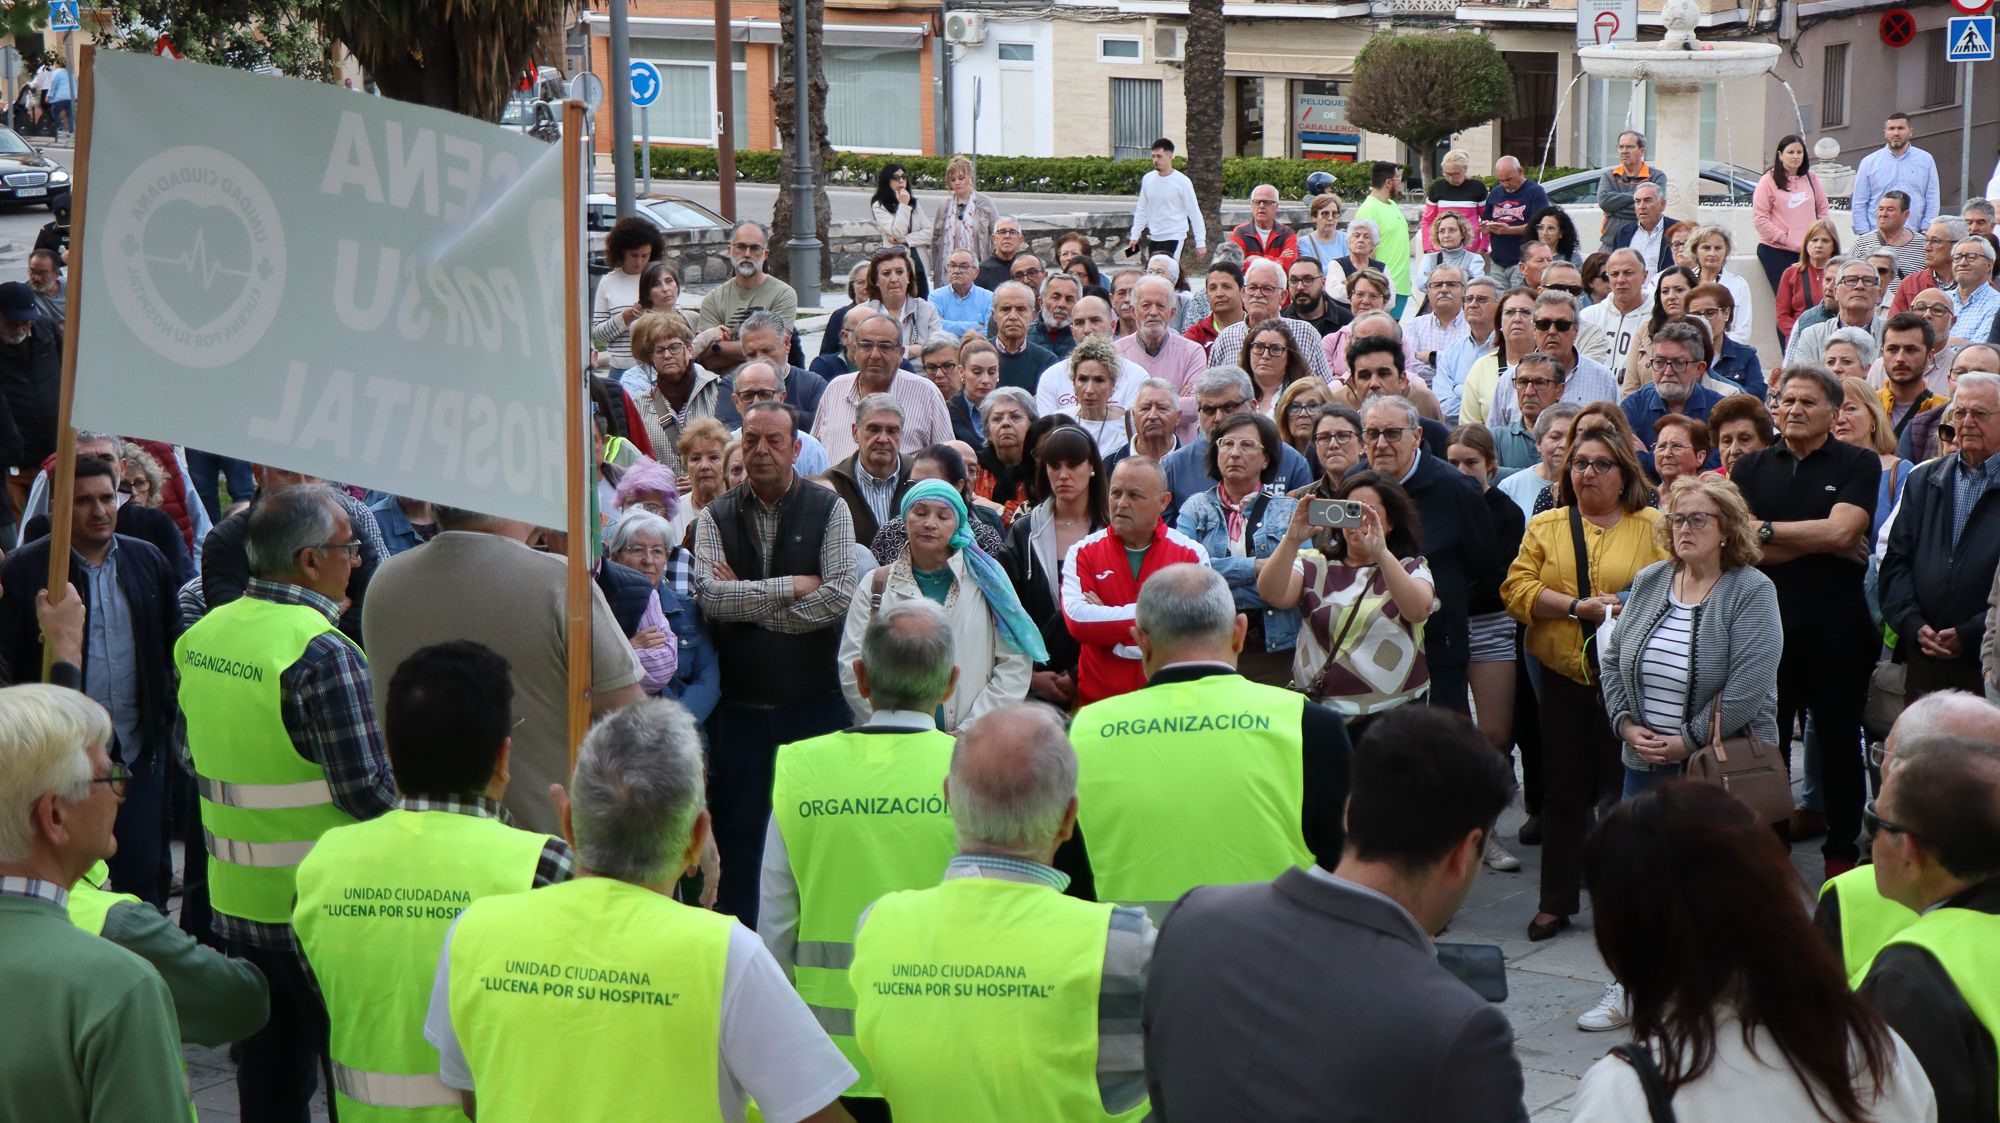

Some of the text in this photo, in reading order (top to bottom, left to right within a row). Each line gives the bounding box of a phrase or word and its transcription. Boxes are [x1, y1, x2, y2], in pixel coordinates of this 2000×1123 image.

[1323, 111, 1337, 119] DE
[1298, 123, 1361, 133] CABALLEROS
[1100, 710, 1270, 738] ORGANIZACIÓN
[343, 887, 471, 903] UNIDAD CIUDADANA
[379, 904, 404, 918] POR
[406, 905, 423, 919] SU
[426, 907, 468, 920] HOSP
[505, 960, 652, 986] UNIDAD CIUDADANA
[892, 963, 1027, 979] UNIDAD CIUDADANA
[542, 982, 574, 999] POR
[576, 986, 596, 1001] SU
[925, 983, 951, 997] POR
[953, 983, 974, 997] SU
